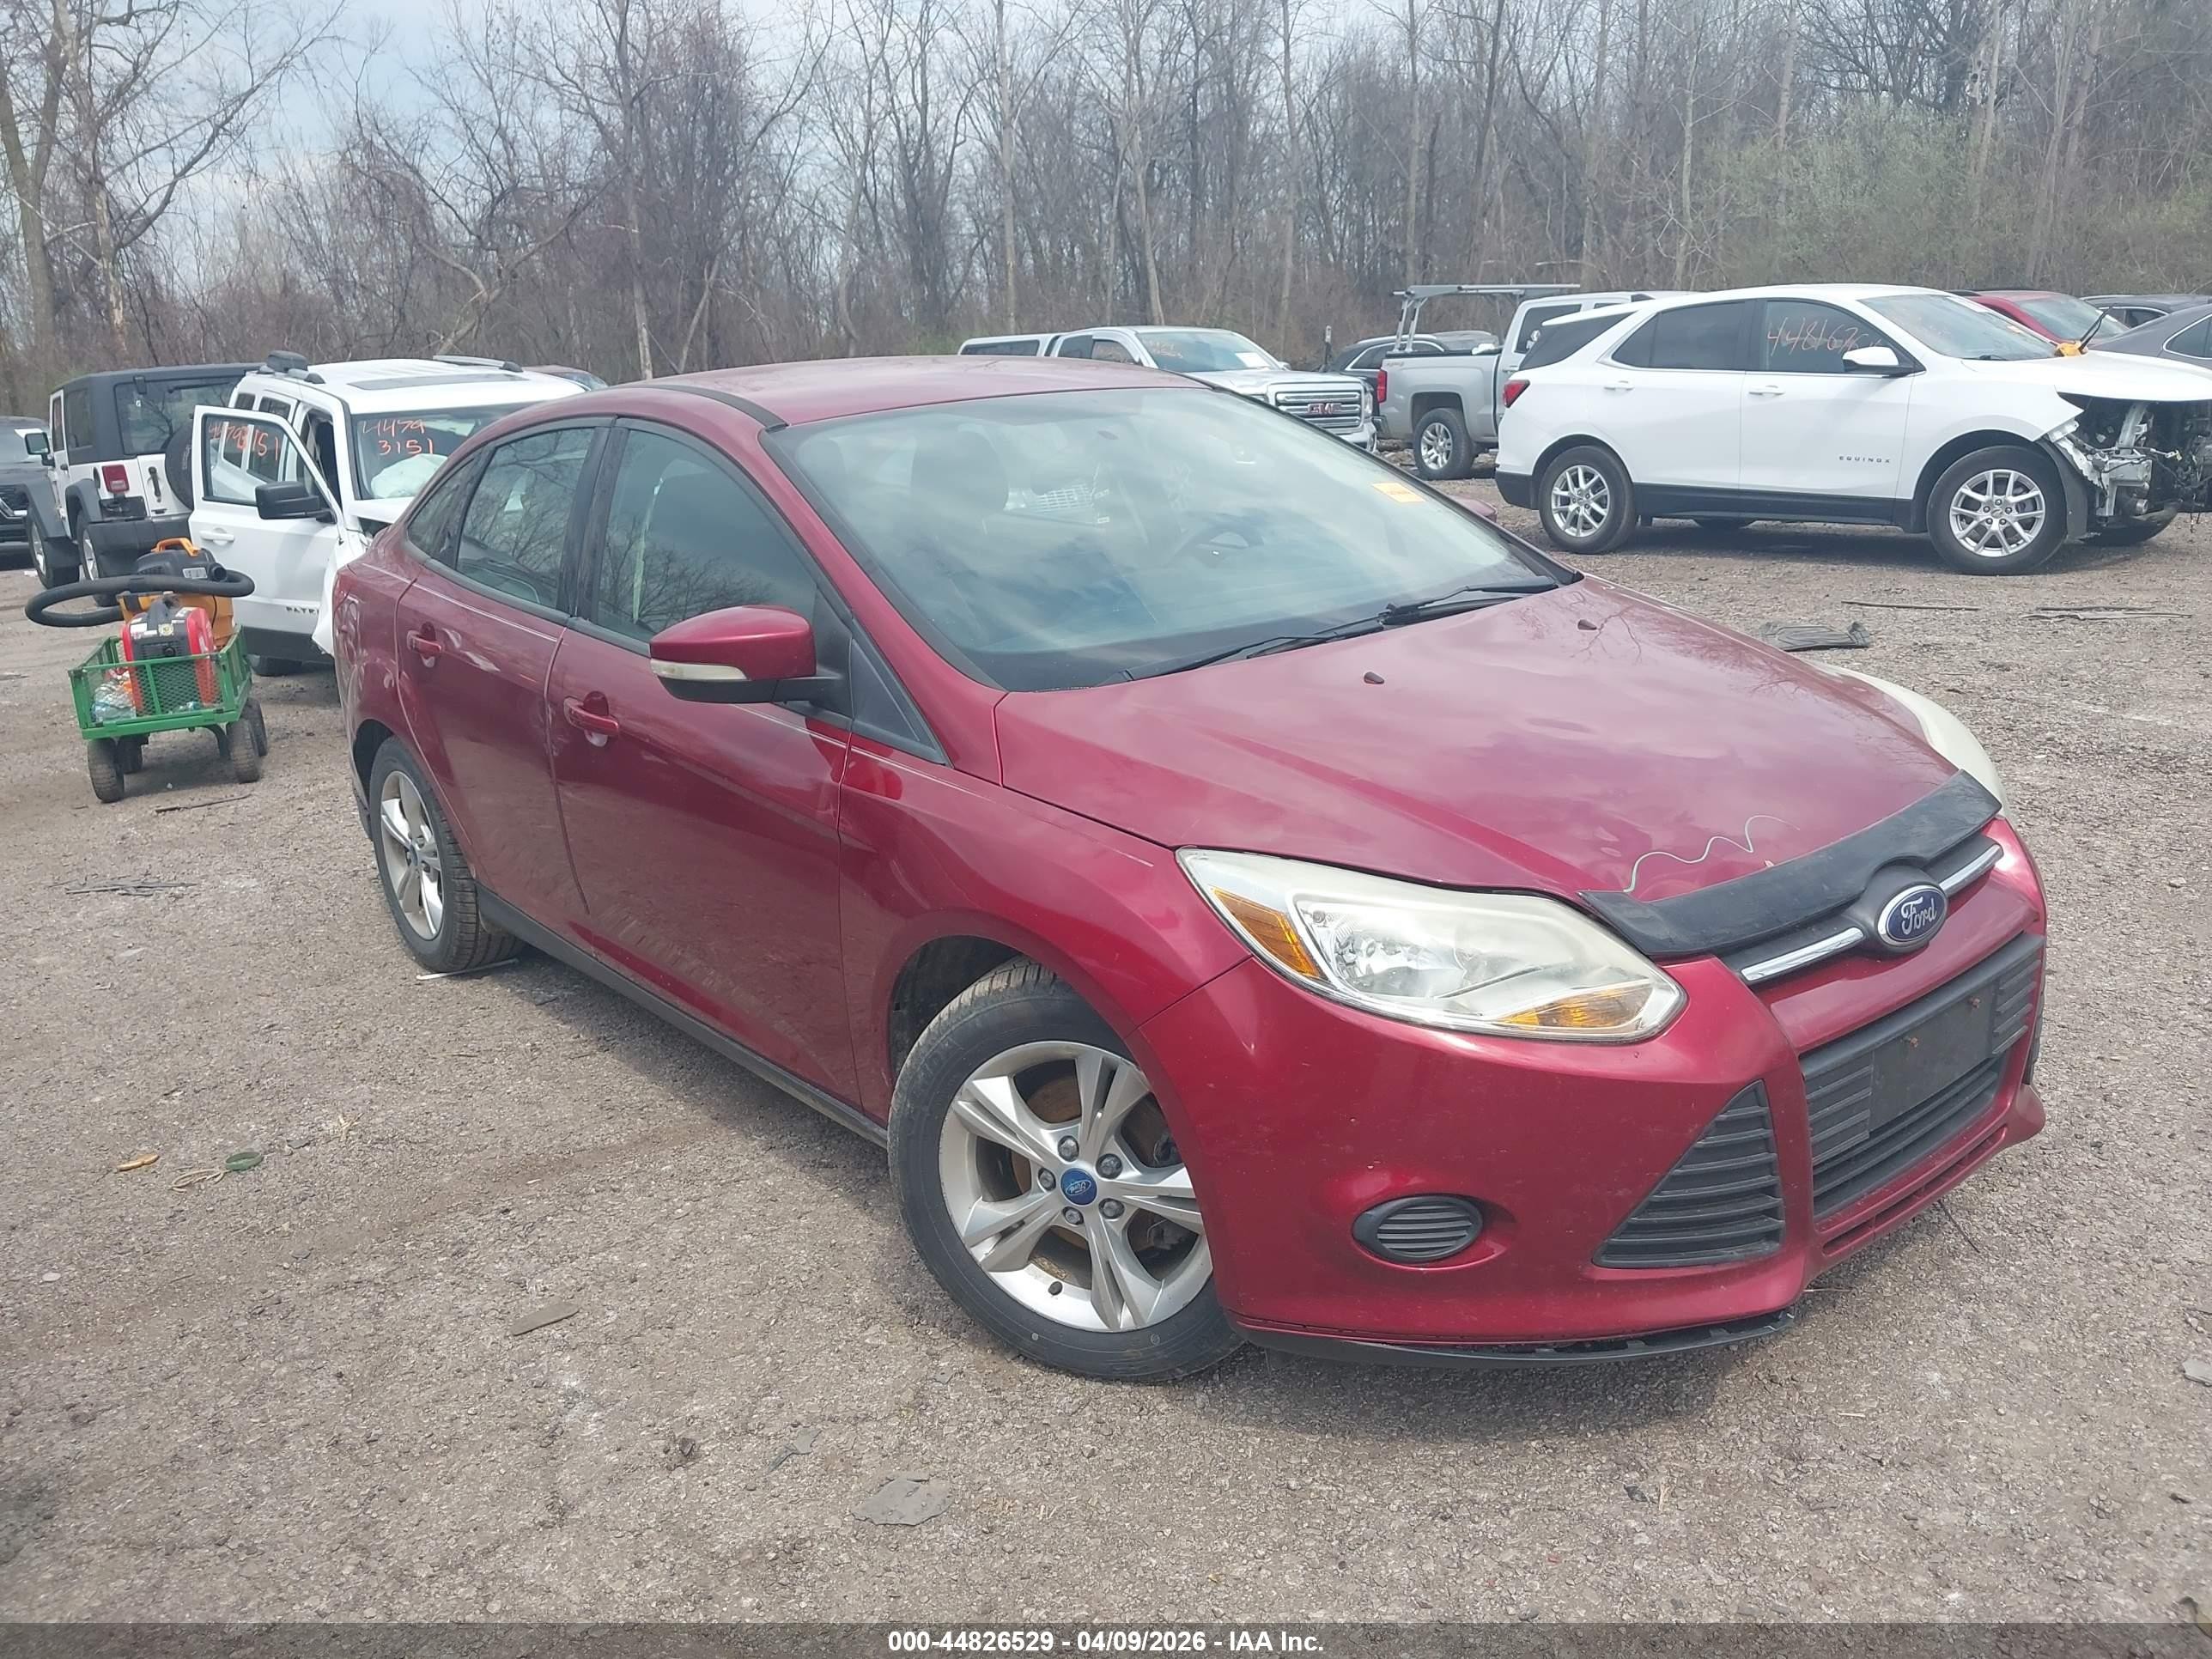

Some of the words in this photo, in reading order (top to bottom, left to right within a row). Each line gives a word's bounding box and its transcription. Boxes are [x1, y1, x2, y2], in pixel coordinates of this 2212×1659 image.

[362, 418, 425, 437] 4479
[379, 438, 433, 455] 3151
[285, 605, 319, 615] PATRI
[1901, 896, 1937, 935] Ford
